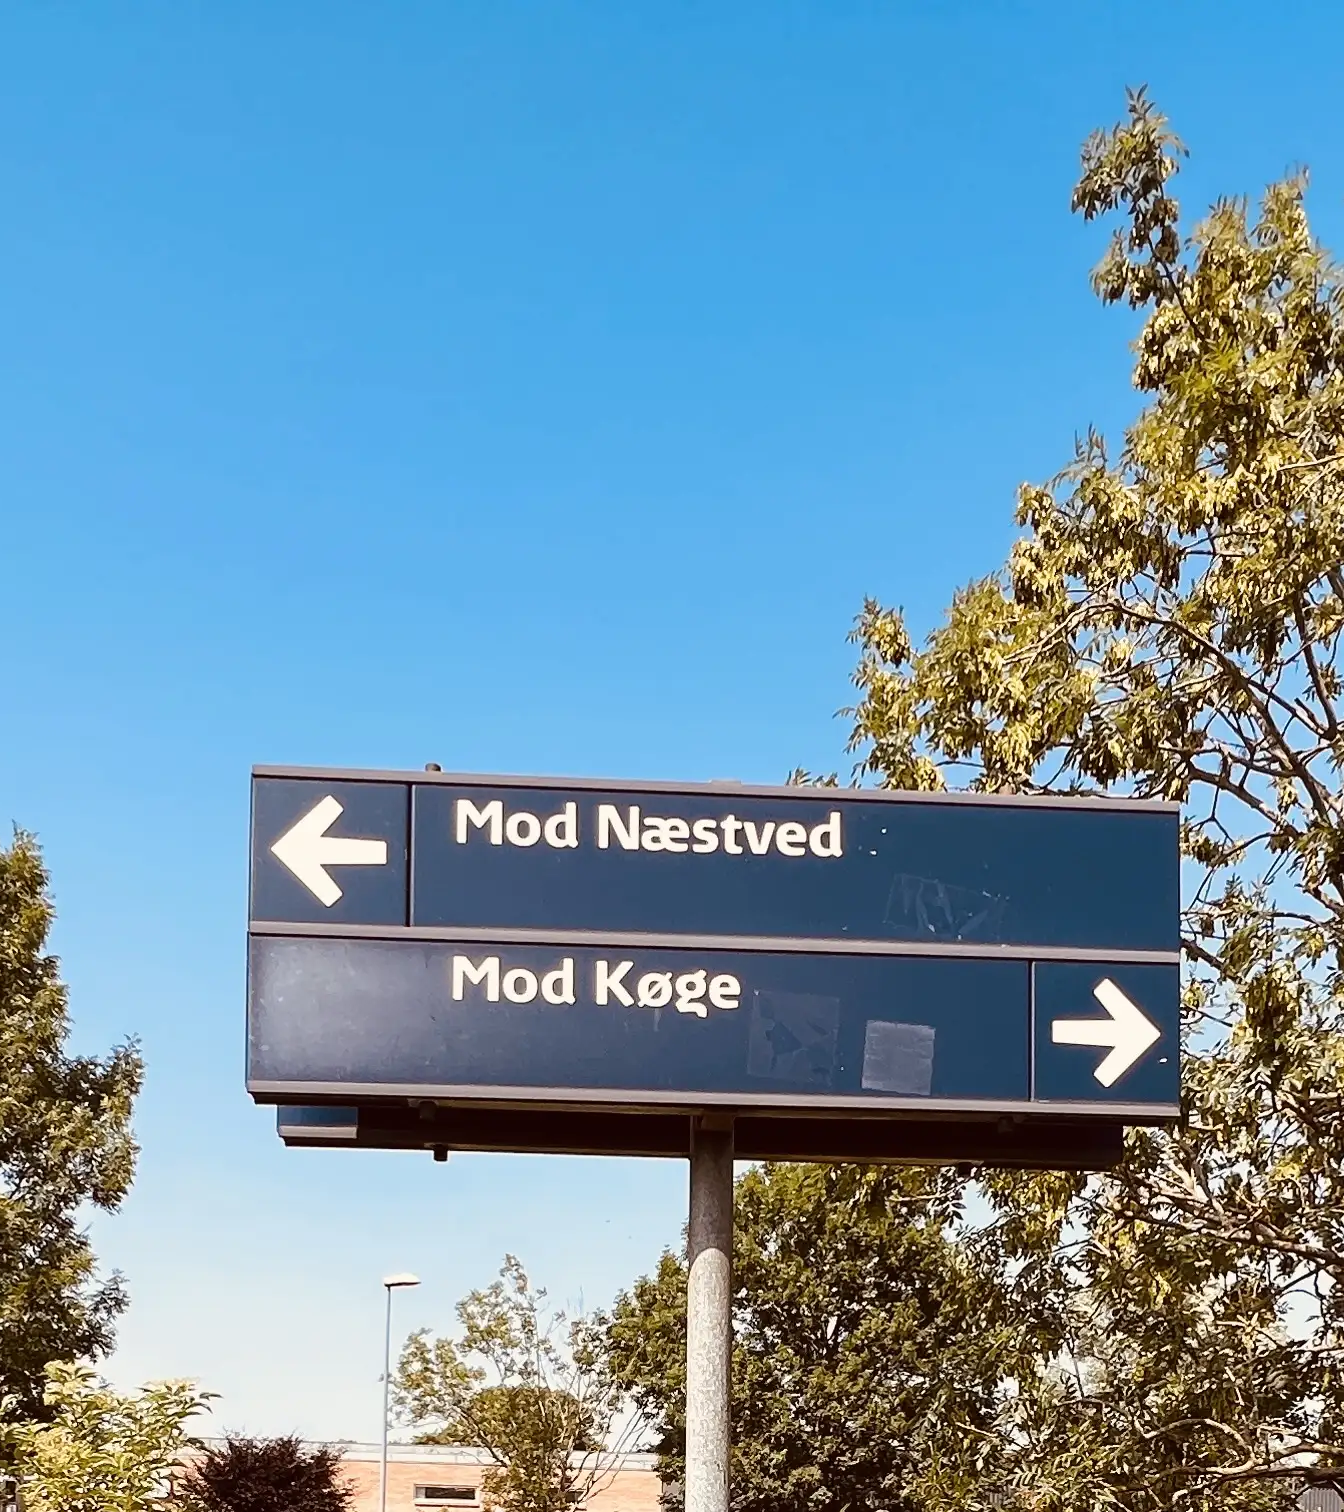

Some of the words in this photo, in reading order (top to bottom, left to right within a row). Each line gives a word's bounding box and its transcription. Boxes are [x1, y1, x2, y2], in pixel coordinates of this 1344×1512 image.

[455, 799, 579, 849] Mod
[597, 804, 844, 859] Næstved
[451, 955, 576, 1006] Mod
[594, 960, 742, 1018] Køge
